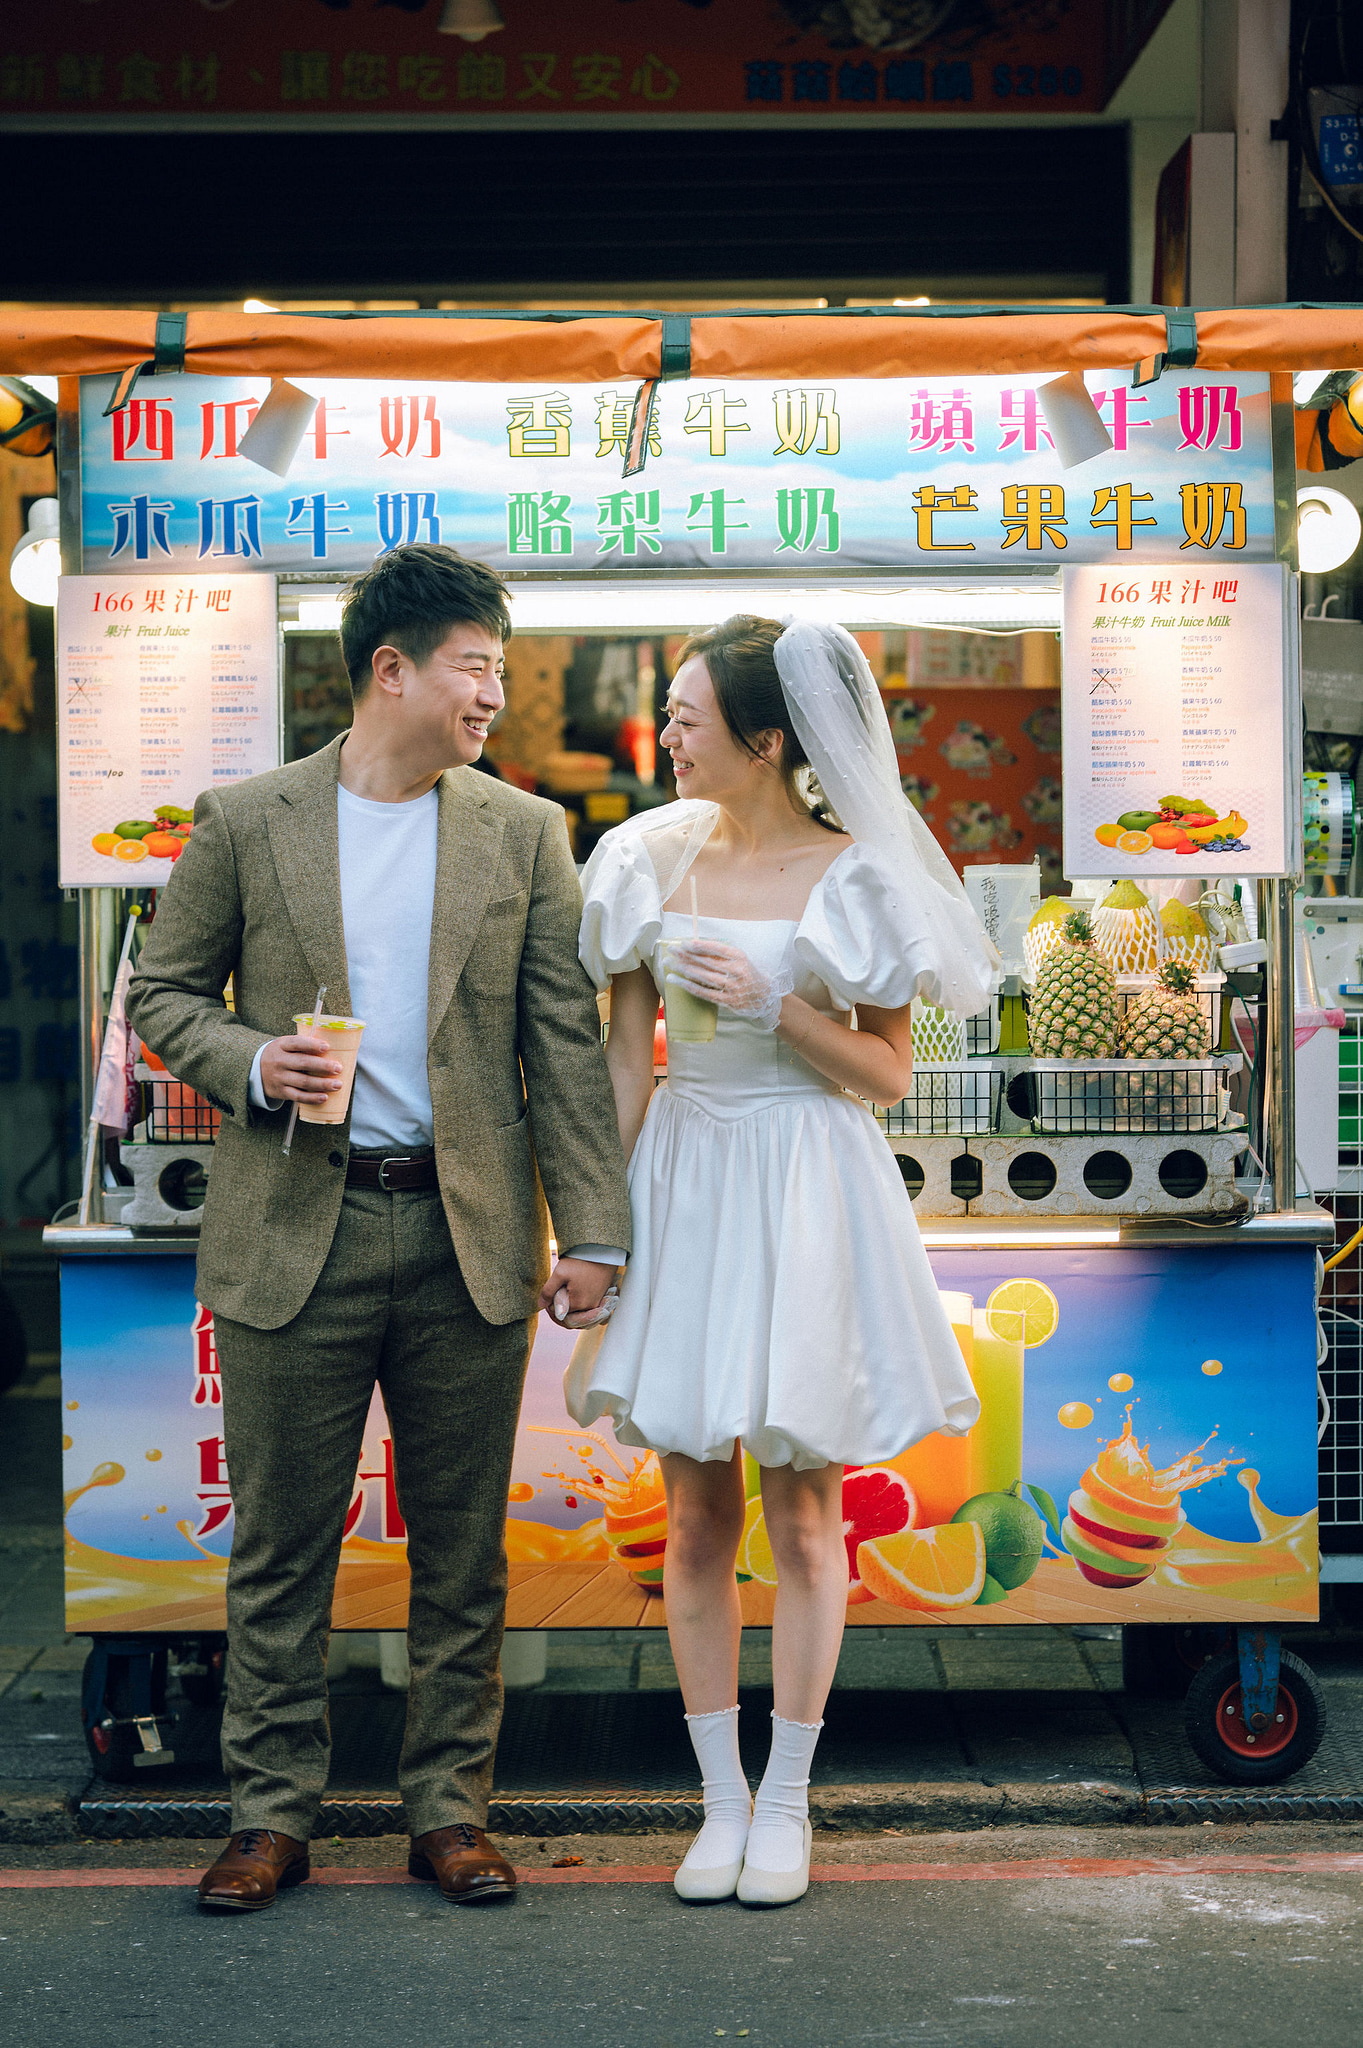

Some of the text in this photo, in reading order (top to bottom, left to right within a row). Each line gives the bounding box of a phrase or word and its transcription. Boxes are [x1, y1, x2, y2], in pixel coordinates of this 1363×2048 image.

[109, 491, 440, 560] 木瓜牛奶
[506, 487, 841, 557] 酪梨牛奶
[911, 482, 1248, 551] 芒果牛奶
[90, 588, 232, 613] 166 果汁吧
[1096, 579, 1238, 604] 166 果汁吧
[103, 624, 190, 638] 果汁 Fruit Juice
[1092, 616, 1232, 629] 果汁牛奶 Fruit Juice Milk
